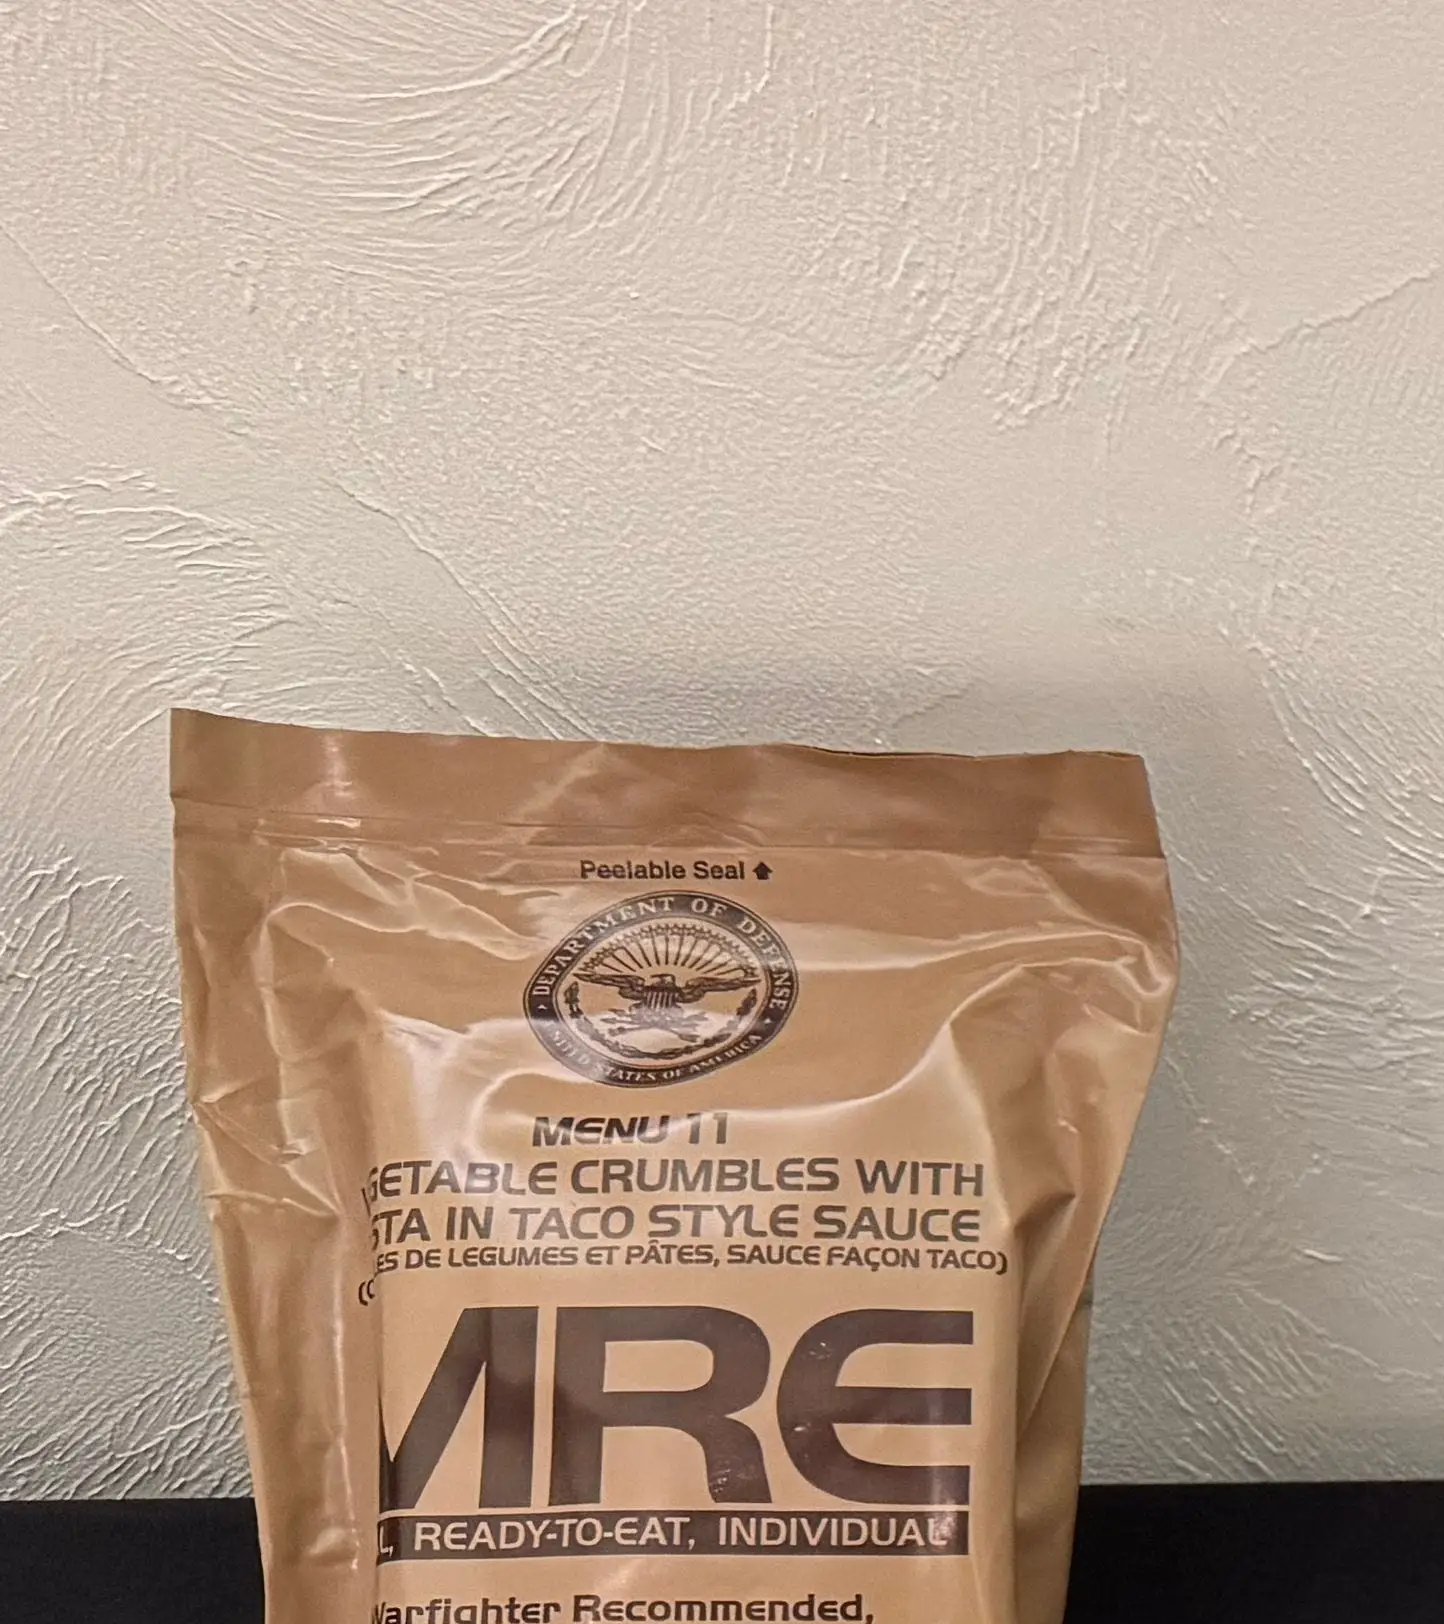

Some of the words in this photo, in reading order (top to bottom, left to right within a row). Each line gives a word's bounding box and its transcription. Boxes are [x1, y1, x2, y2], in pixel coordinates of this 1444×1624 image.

[579, 859, 686, 880] Peelable
[692, 860, 746, 880] Seal
[531, 896, 676, 997] DEPARTMENT
[690, 897, 727, 917] OF
[735, 911, 793, 1011] DEFENSE
[532, 1114, 670, 1147] MENU
[687, 1112, 729, 1145] 11
[570, 1157, 840, 1194] CRUMBLES
[855, 1158, 984, 1197] WITH
[445, 1206, 494, 1241] IN
[509, 1205, 635, 1241] TACO
[648, 1203, 800, 1239] STYLE
[813, 1204, 981, 1243] SAUCE
[404, 1249, 442, 1270] DE
[447, 1246, 578, 1268] LEGUMES
[585, 1245, 620, 1266] ET
[624, 1239, 720, 1268] PÂTES,
[726, 1243, 822, 1267] SAUCE
[826, 1245, 921, 1272] FAÇON
[926, 1248, 1008, 1276] TACO)
[414, 1515, 696, 1551] READY-TO-EAT,
[718, 1515, 949, 1548] INDIVIDUAL
